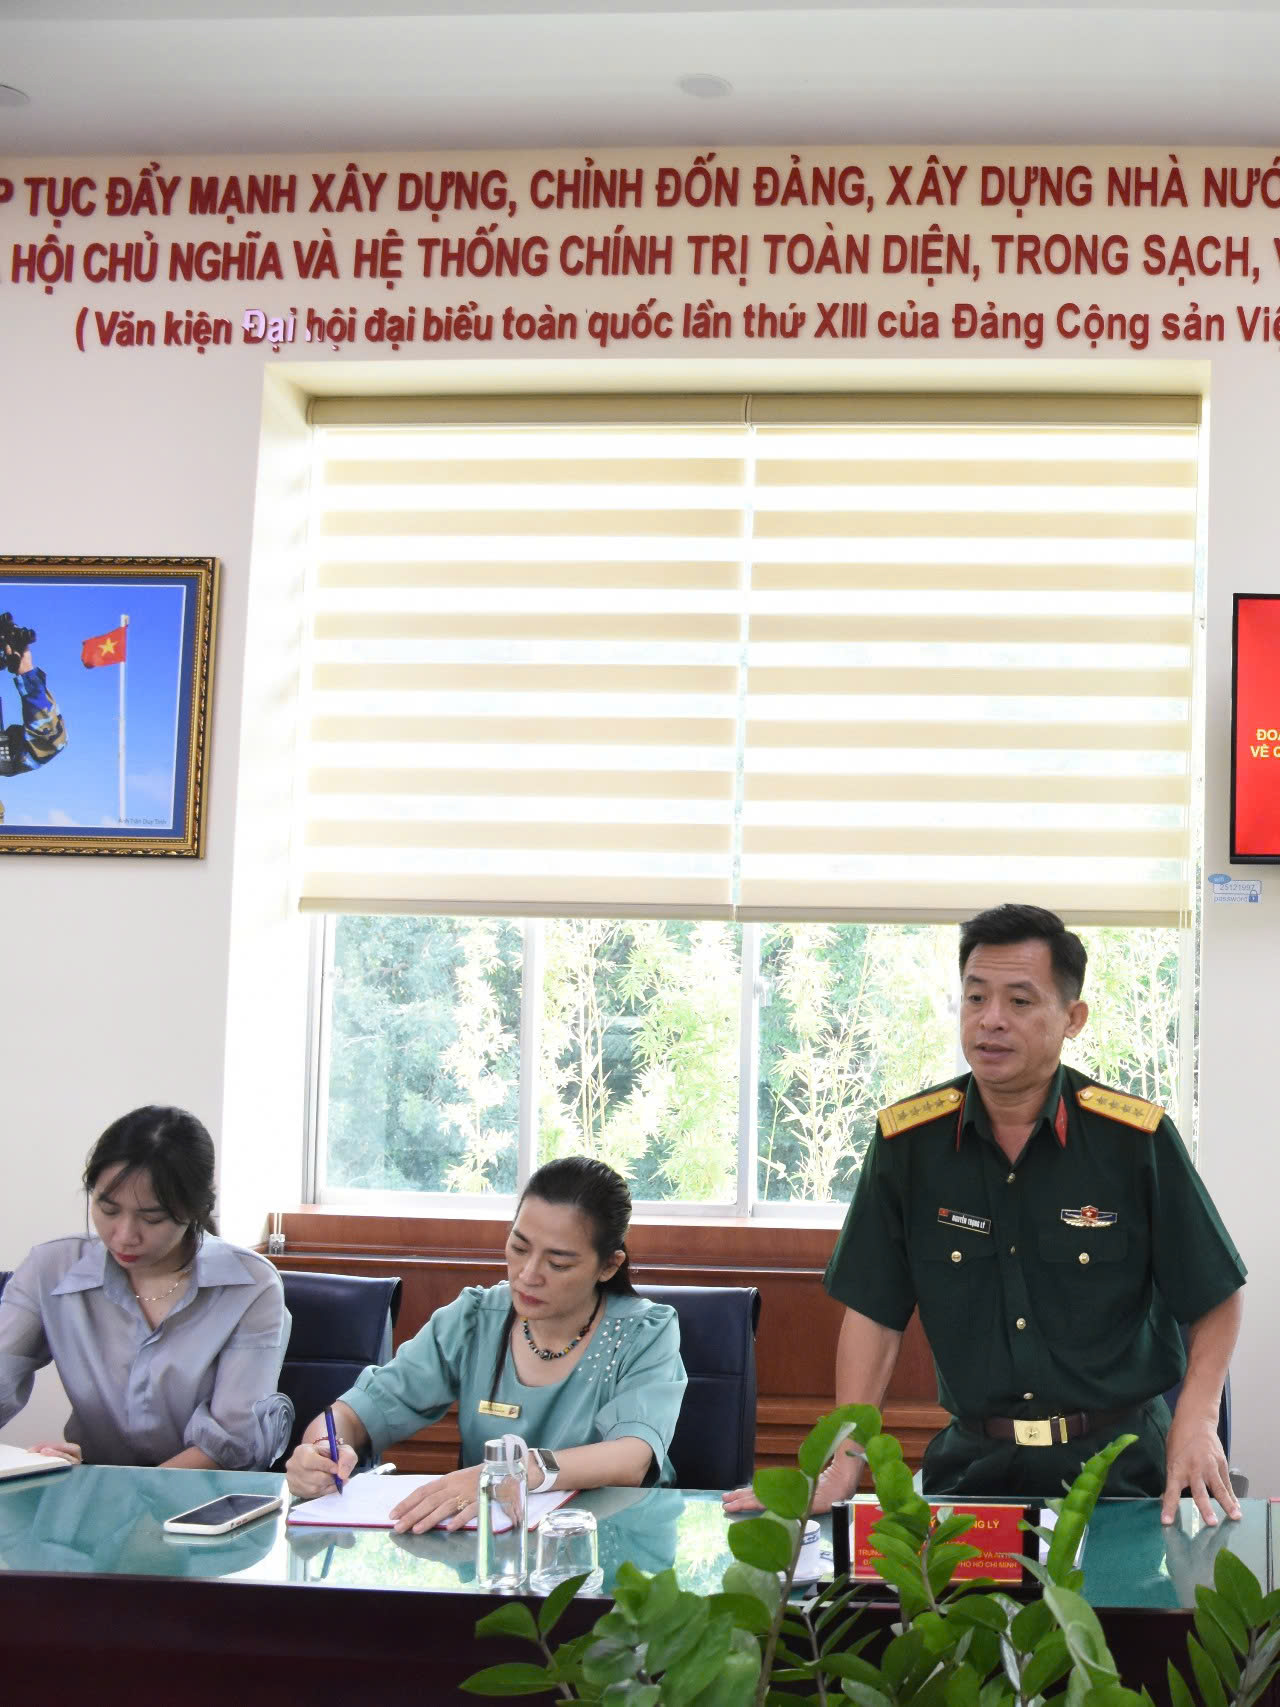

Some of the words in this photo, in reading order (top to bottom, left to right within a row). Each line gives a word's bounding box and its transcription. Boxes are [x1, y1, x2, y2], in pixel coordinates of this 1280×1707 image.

[24, 176, 96, 228] TỤC
[106, 163, 179, 216] ĐẨY
[188, 176, 296, 224] MẠNH
[311, 163, 386, 212] XÂY
[399, 170, 517, 222] DỰNG,
[531, 158, 643, 208] CHỈNH
[656, 152, 739, 208] ĐỐN
[754, 155, 874, 211] ĐẢNG,
[888, 155, 968, 205] XÂY
[981, 165, 1093, 218] DỰNG
[1108, 155, 1188, 208] NHÀ
[11, 235, 73, 294] HỘI
[84, 232, 158, 283] CHỦ
[169, 232, 283, 281] NGHĨA
[293, 229, 339, 279] VÀ
[354, 228, 404, 288] HỆ
[418, 224, 548, 277] THỐNG
[560, 224, 672, 276] CHÍNH
[688, 234, 749, 286] TRỊ
[763, 223, 870, 275] TOÀN
[883, 224, 980, 286] DIỆN,
[992, 234, 1128, 275] TRONG
[1144, 235, 1259, 285] SẠCH,
[164, 310, 232, 352] kiện
[241, 308, 298, 353] Đại
[304, 307, 357, 351] hội
[365, 307, 415, 350] đại
[424, 302, 493, 341] biểu
[502, 305, 576, 340] toàn
[588, 299, 672, 347] quốc
[683, 300, 731, 338] lần
[744, 304, 806, 338] thứ
[816, 304, 867, 338] XIII
[878, 300, 939, 339] của
[953, 301, 1045, 350] Đảng
[1056, 302, 1150, 350] Cộng
[1163, 302, 1224, 341] sản
